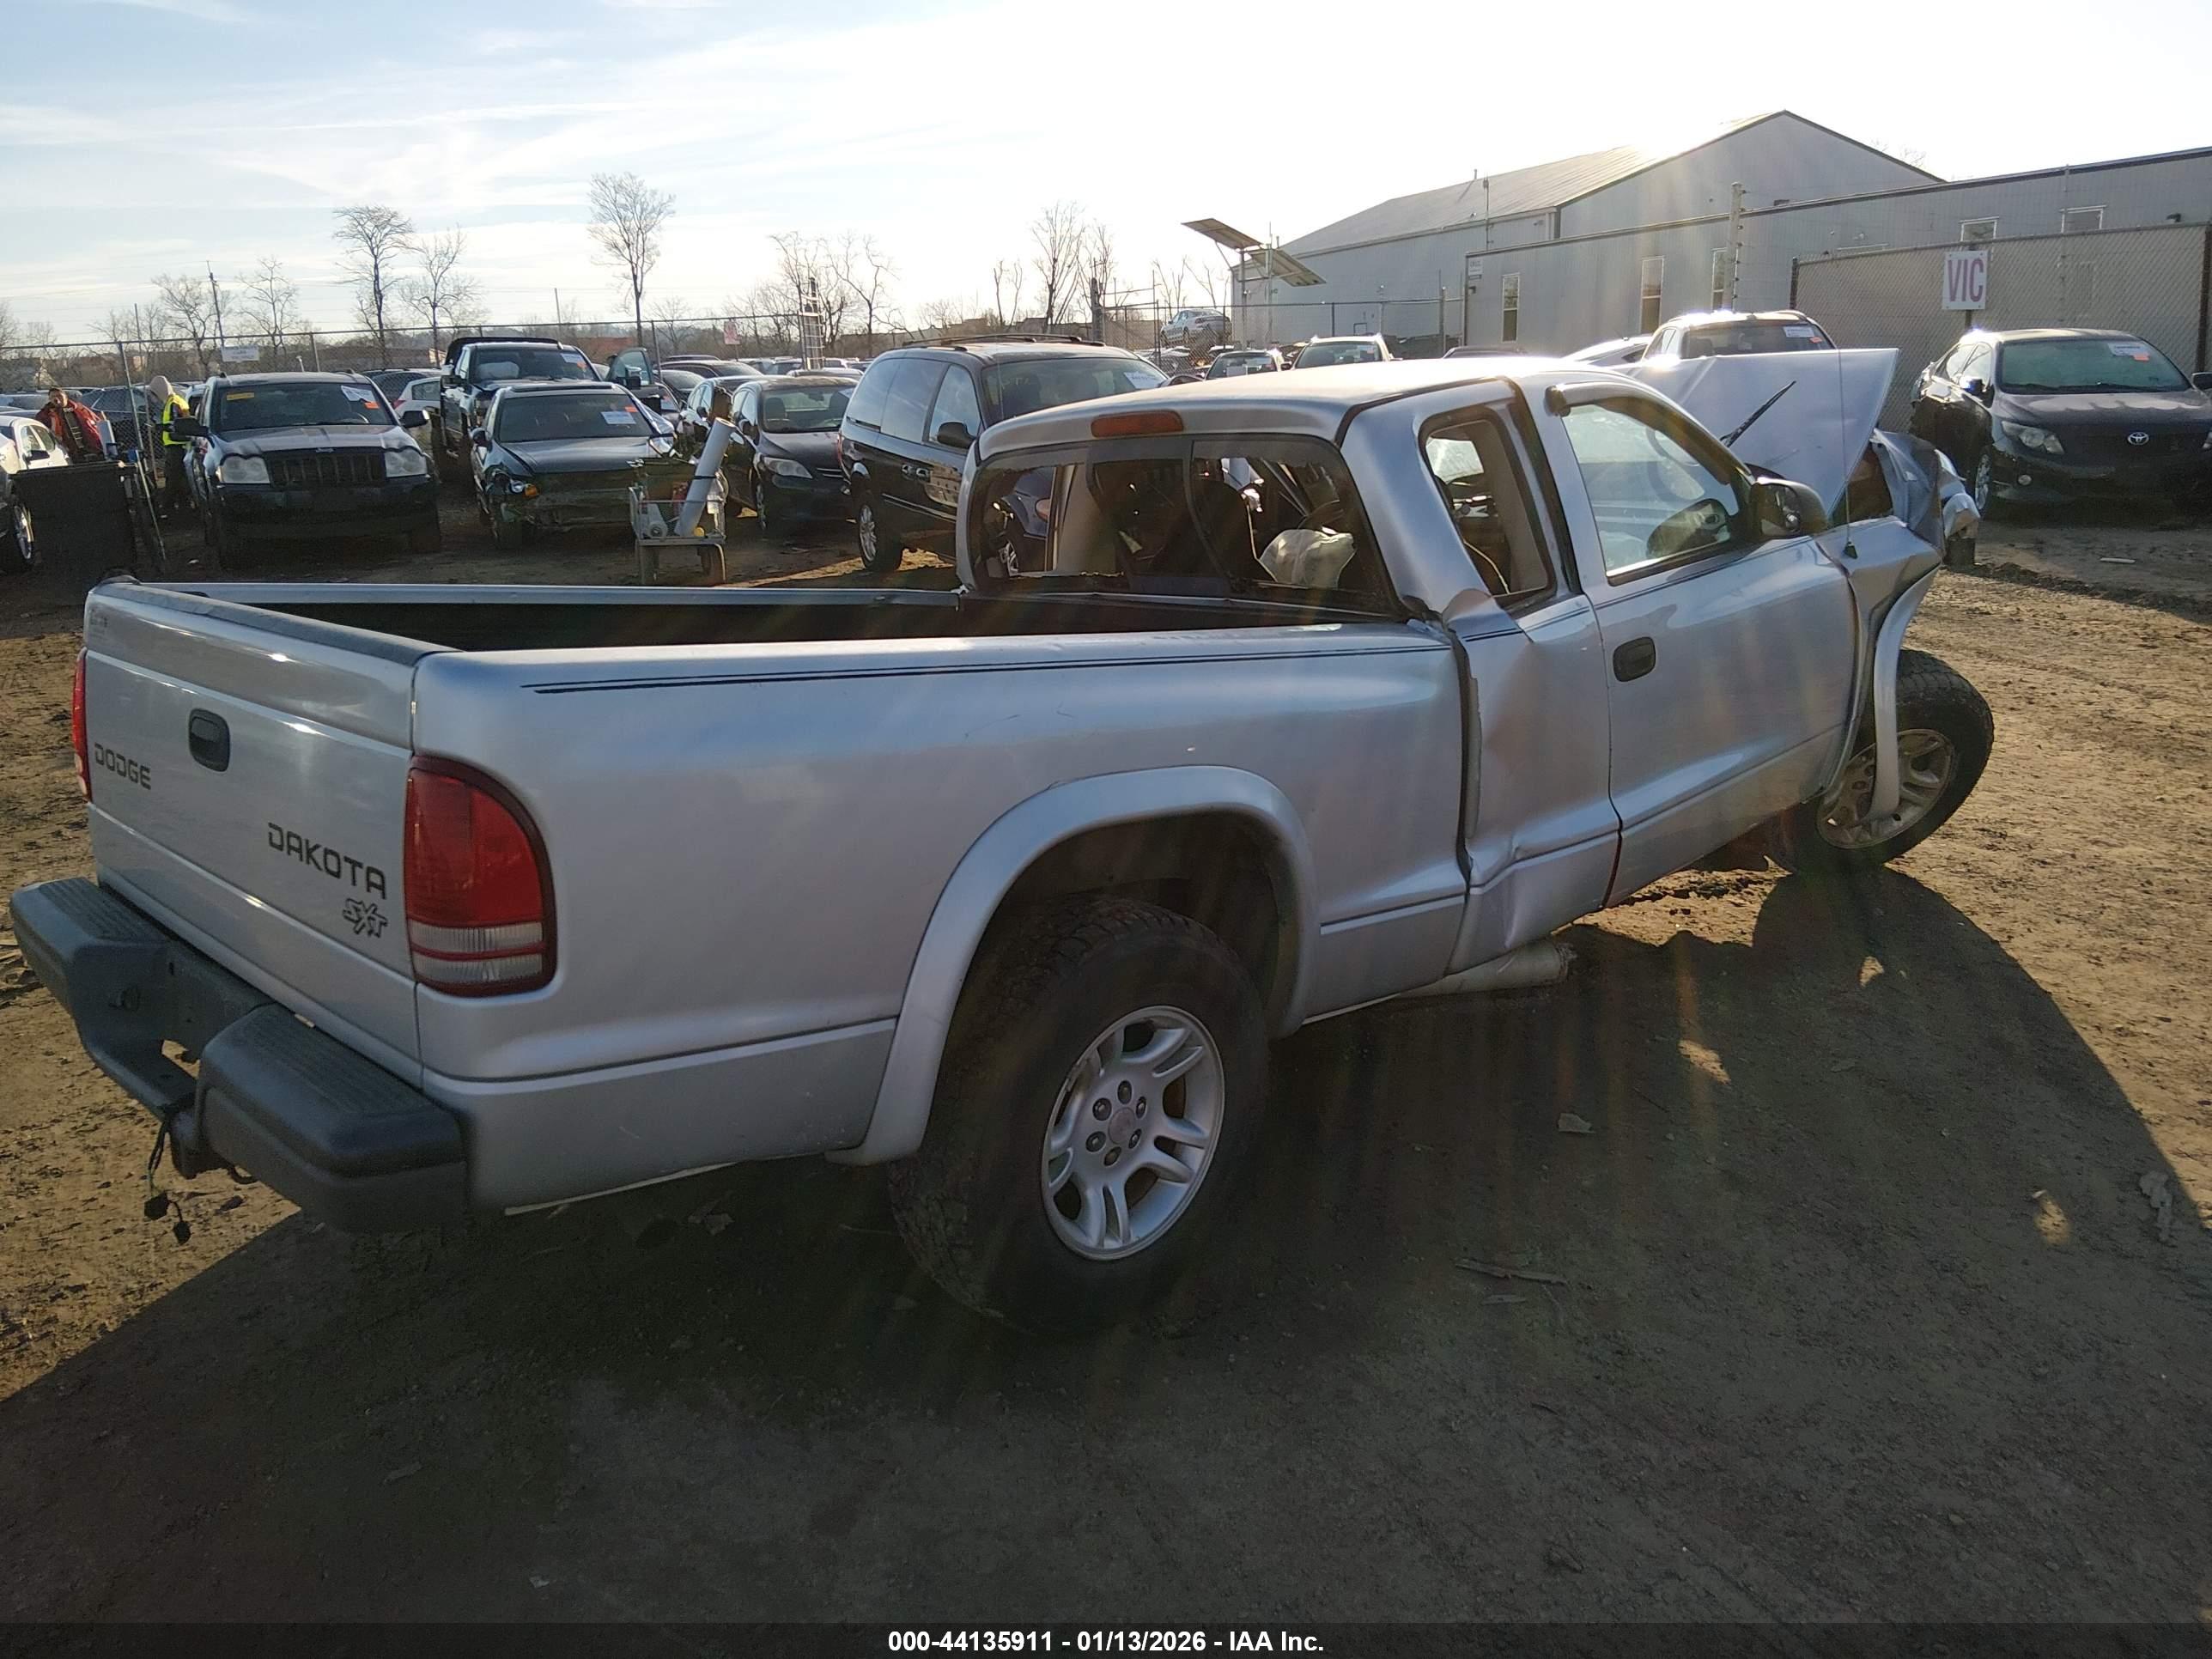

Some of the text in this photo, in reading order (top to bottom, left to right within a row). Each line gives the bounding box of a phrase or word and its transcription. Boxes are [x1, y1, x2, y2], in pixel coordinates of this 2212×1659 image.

[1948, 258, 1984, 302] VIC
[94, 742, 151, 790] DODGE
[268, 822, 386, 900] DAKOTA
[343, 897, 388, 938] SXT
